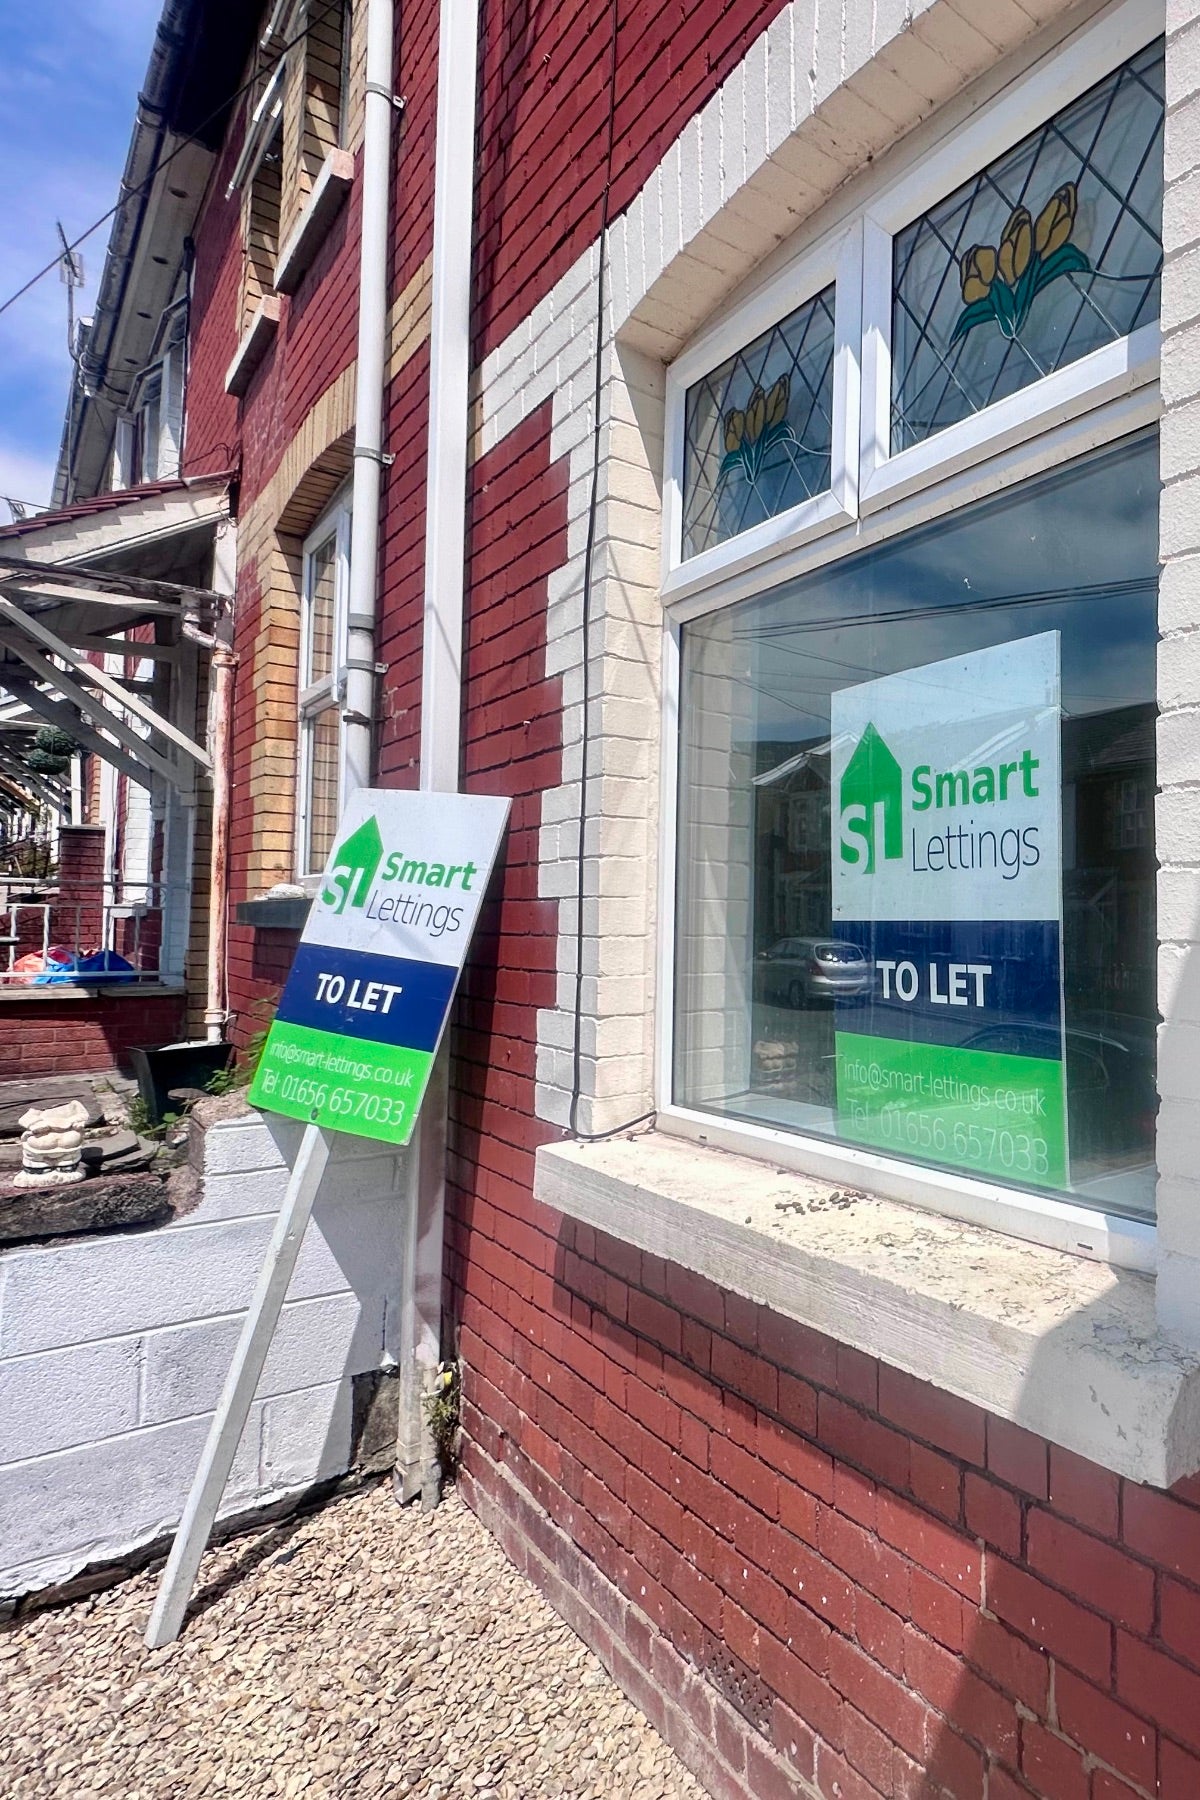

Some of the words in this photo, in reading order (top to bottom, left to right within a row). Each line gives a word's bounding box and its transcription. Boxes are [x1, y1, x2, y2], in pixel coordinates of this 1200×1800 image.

[912, 750, 1040, 811] Smart
[381, 852, 478, 891] Smart
[912, 819, 1040, 880] Lettings
[366, 890, 464, 936] Lettings
[315, 972, 346, 1004] TO
[347, 981, 402, 1014] LET
[876, 961, 919, 1001] TO
[929, 962, 992, 1007] LET
[270, 1039, 415, 1087] info@smart-lettings.co.uk
[844, 1058, 1047, 1117] info@smart-lettings.co.uk
[261, 1068, 280, 1095] Tel:
[281, 1074, 329, 1108] 01656
[329, 1087, 406, 1126] 657033
[880, 1104, 946, 1150] 01656
[953, 1122, 1049, 1175] 657033
